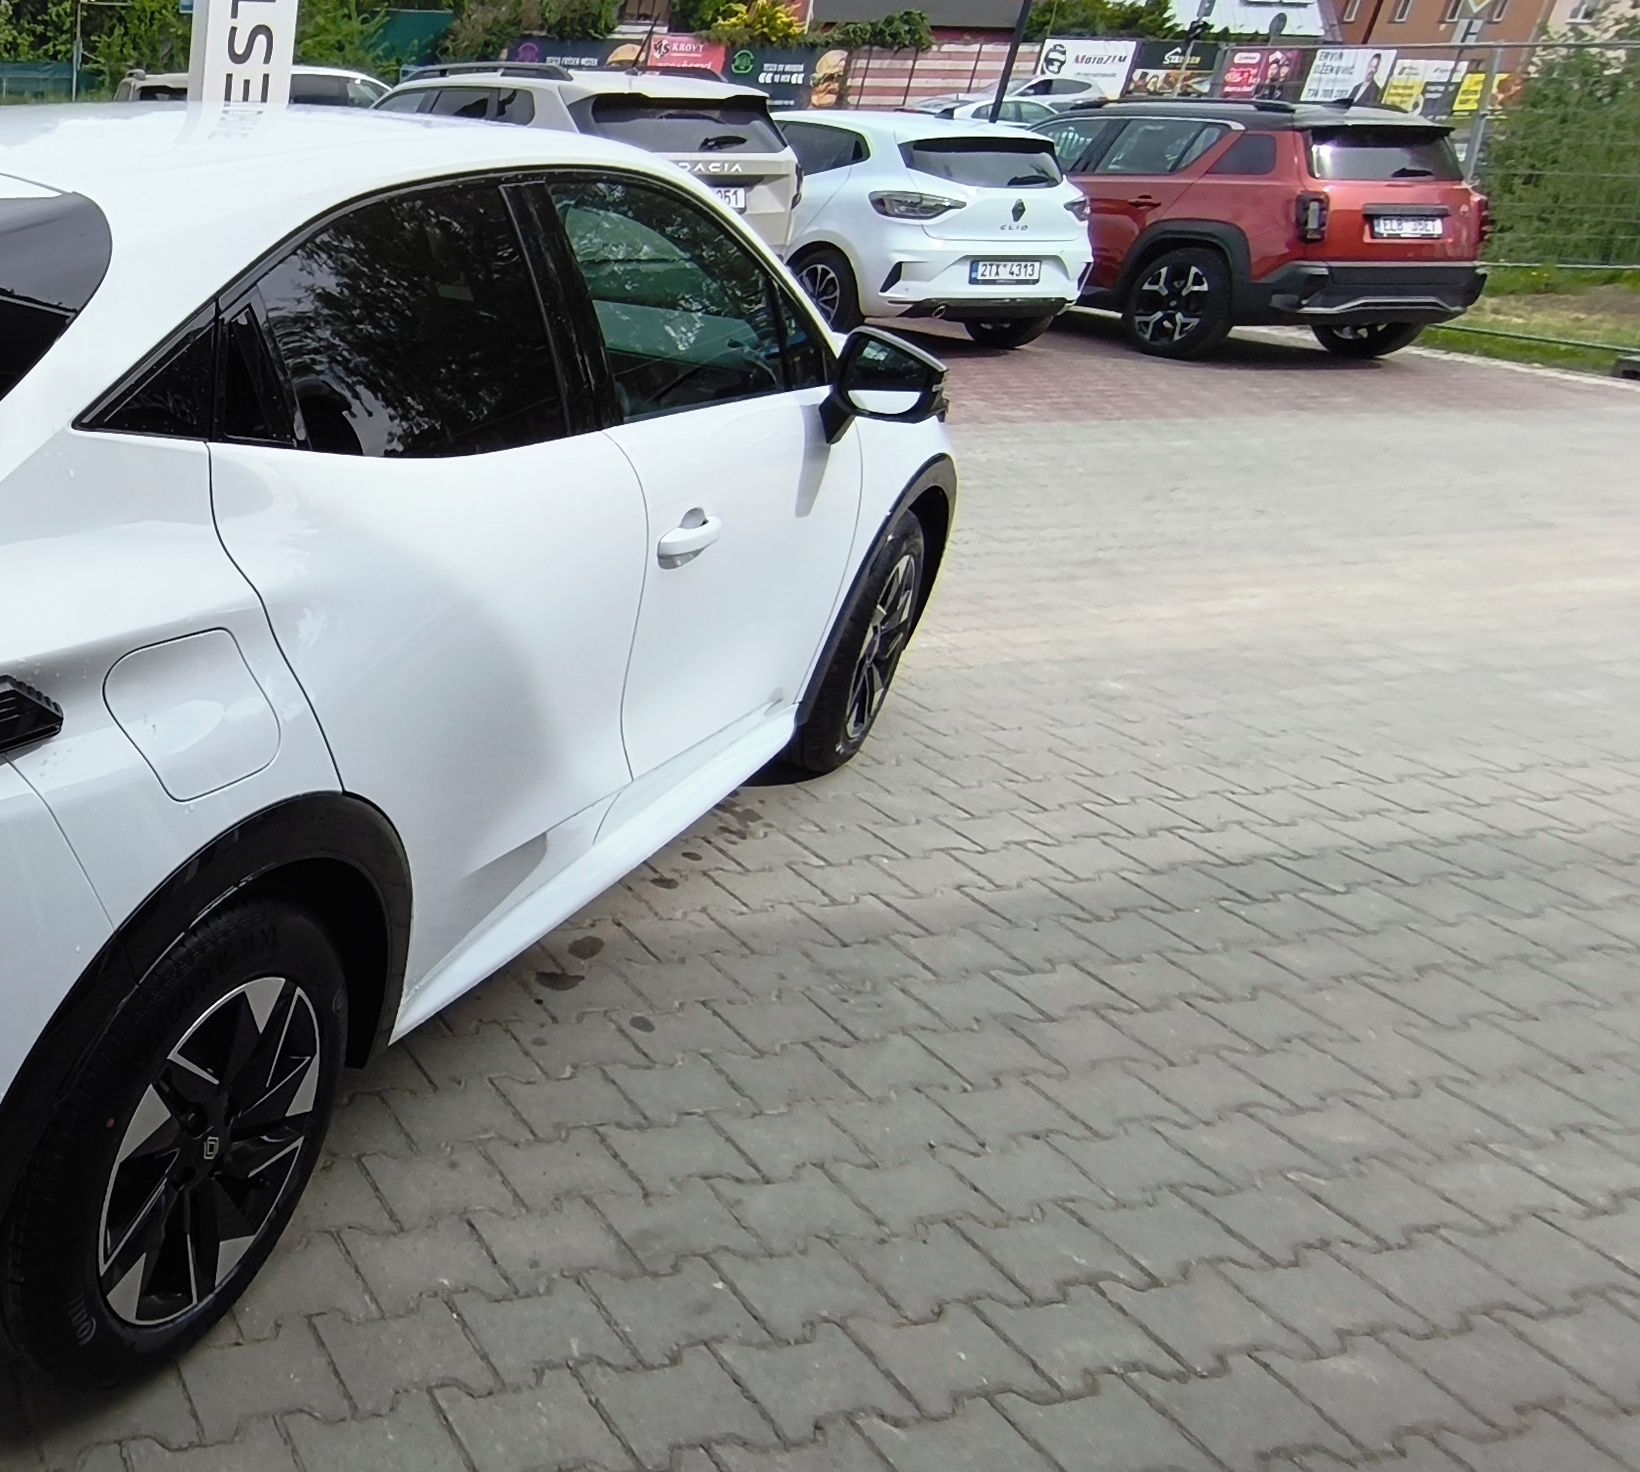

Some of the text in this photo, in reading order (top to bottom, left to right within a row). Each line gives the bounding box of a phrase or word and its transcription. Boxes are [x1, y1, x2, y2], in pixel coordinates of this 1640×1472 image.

[672, 42, 704, 53] KROVY
[678, 162, 743, 173] DACIA
[980, 263, 1035, 277] 2TX 4313
